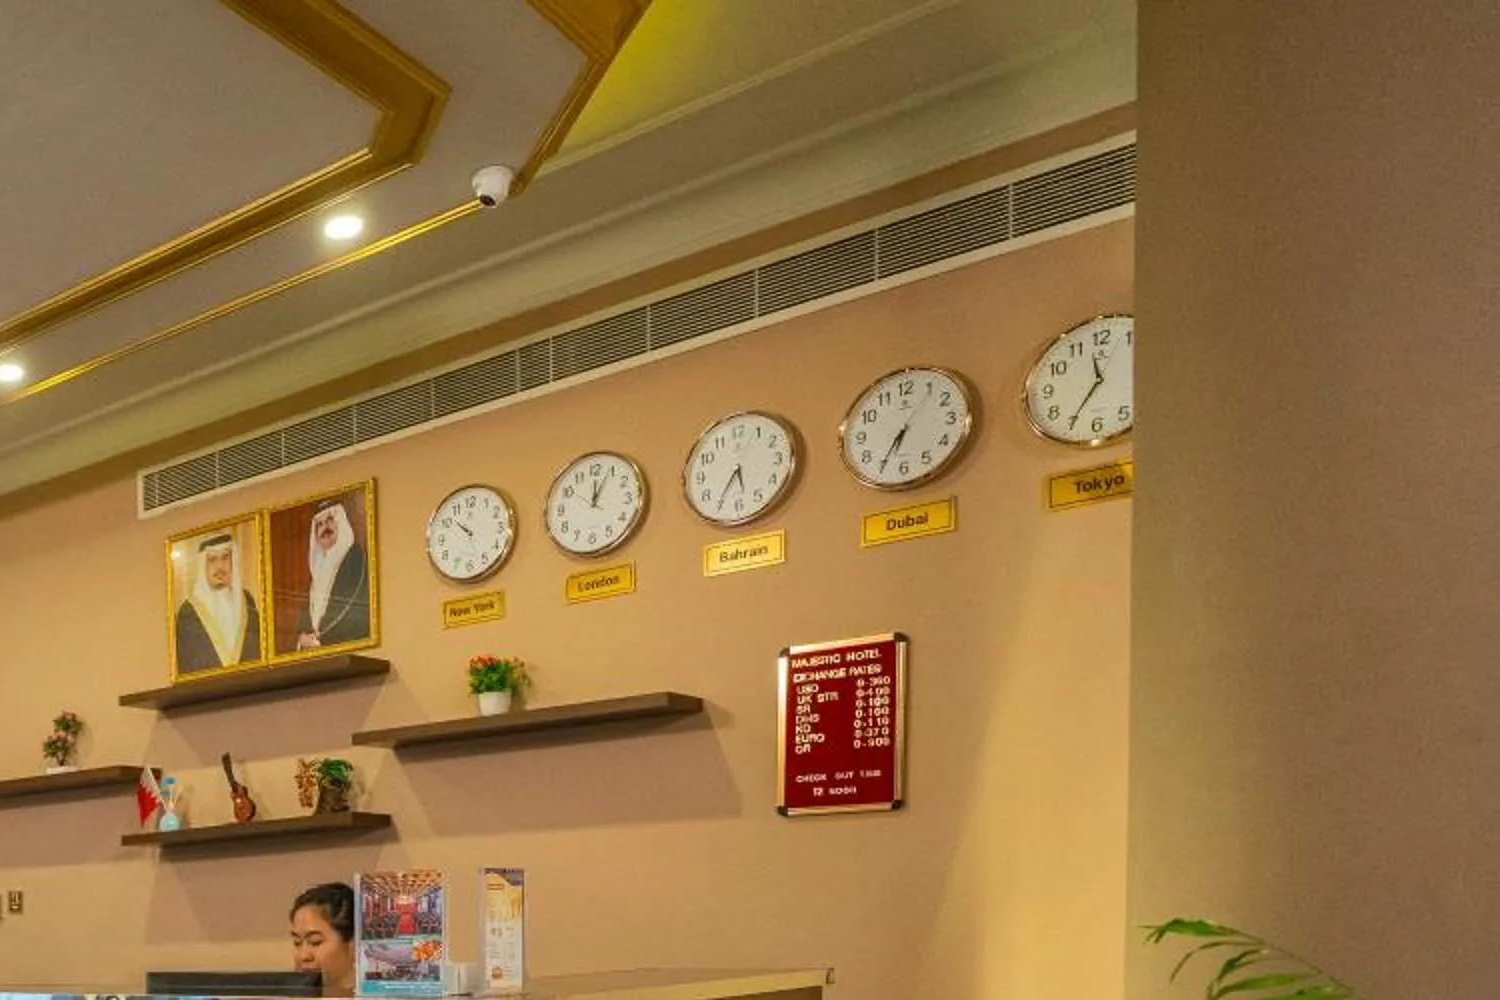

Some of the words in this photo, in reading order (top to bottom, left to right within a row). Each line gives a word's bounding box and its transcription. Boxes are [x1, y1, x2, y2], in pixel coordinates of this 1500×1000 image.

[1093, 330, 1111, 346] 12
[1069, 342, 1084, 357] 11
[1050, 360, 1067, 376] 10
[898, 382, 914, 396] 12
[1043, 384, 1054, 400] 9
[878, 392, 891, 406] 11
[939, 392, 950, 407] 2
[862, 410, 877, 424] 10
[946, 411, 956, 425] 3
[1048, 405, 1060, 421] 8
[1118, 406, 1130, 421] 5
[1092, 417, 1104, 432] 6
[732, 425, 744, 439] 12
[855, 432, 867, 444] 9
[715, 437, 725, 449] 11
[769, 435, 777, 449] 2
[938, 434, 948, 446] 4
[701, 453, 714, 466] 10
[774, 452, 782, 465] 3
[862, 451, 872, 464] 8
[921, 451, 932, 464] 5
[590, 464, 601, 477] 12
[900, 462, 908, 475] 6
[575, 472, 584, 484] 11
[620, 476, 628, 488] 2
[696, 471, 706, 484] 9
[768, 474, 777, 484] 4
[1075, 474, 1125, 493] Tokyo
[564, 485, 574, 498] 10
[624, 492, 632, 504] 3
[702, 489, 711, 501] 8
[754, 489, 762, 502] 5
[558, 505, 564, 516] 9
[735, 498, 744, 512] 6
[617, 512, 626, 522] 4
[886, 512, 929, 530] Dubai
[561, 521, 568, 533] 8
[606, 525, 612, 537] 5
[588, 533, 596, 544] 6
[720, 545, 769, 563] Bahrain
[578, 575, 620, 592] London
[450, 607, 471, 617] New
[473, 601, 495, 613] York
[846, 648, 882, 661] HOTEL
[794, 668, 846, 683] EXCHANGE
[849, 664, 882, 676] RATES
[797, 684, 819, 694] USD
[797, 695, 812, 704] UK
[796, 724, 811, 734] KD
[796, 733, 825, 744] EURO
[796, 773, 826, 782] CHECK
[834, 771, 854, 780] OUT
